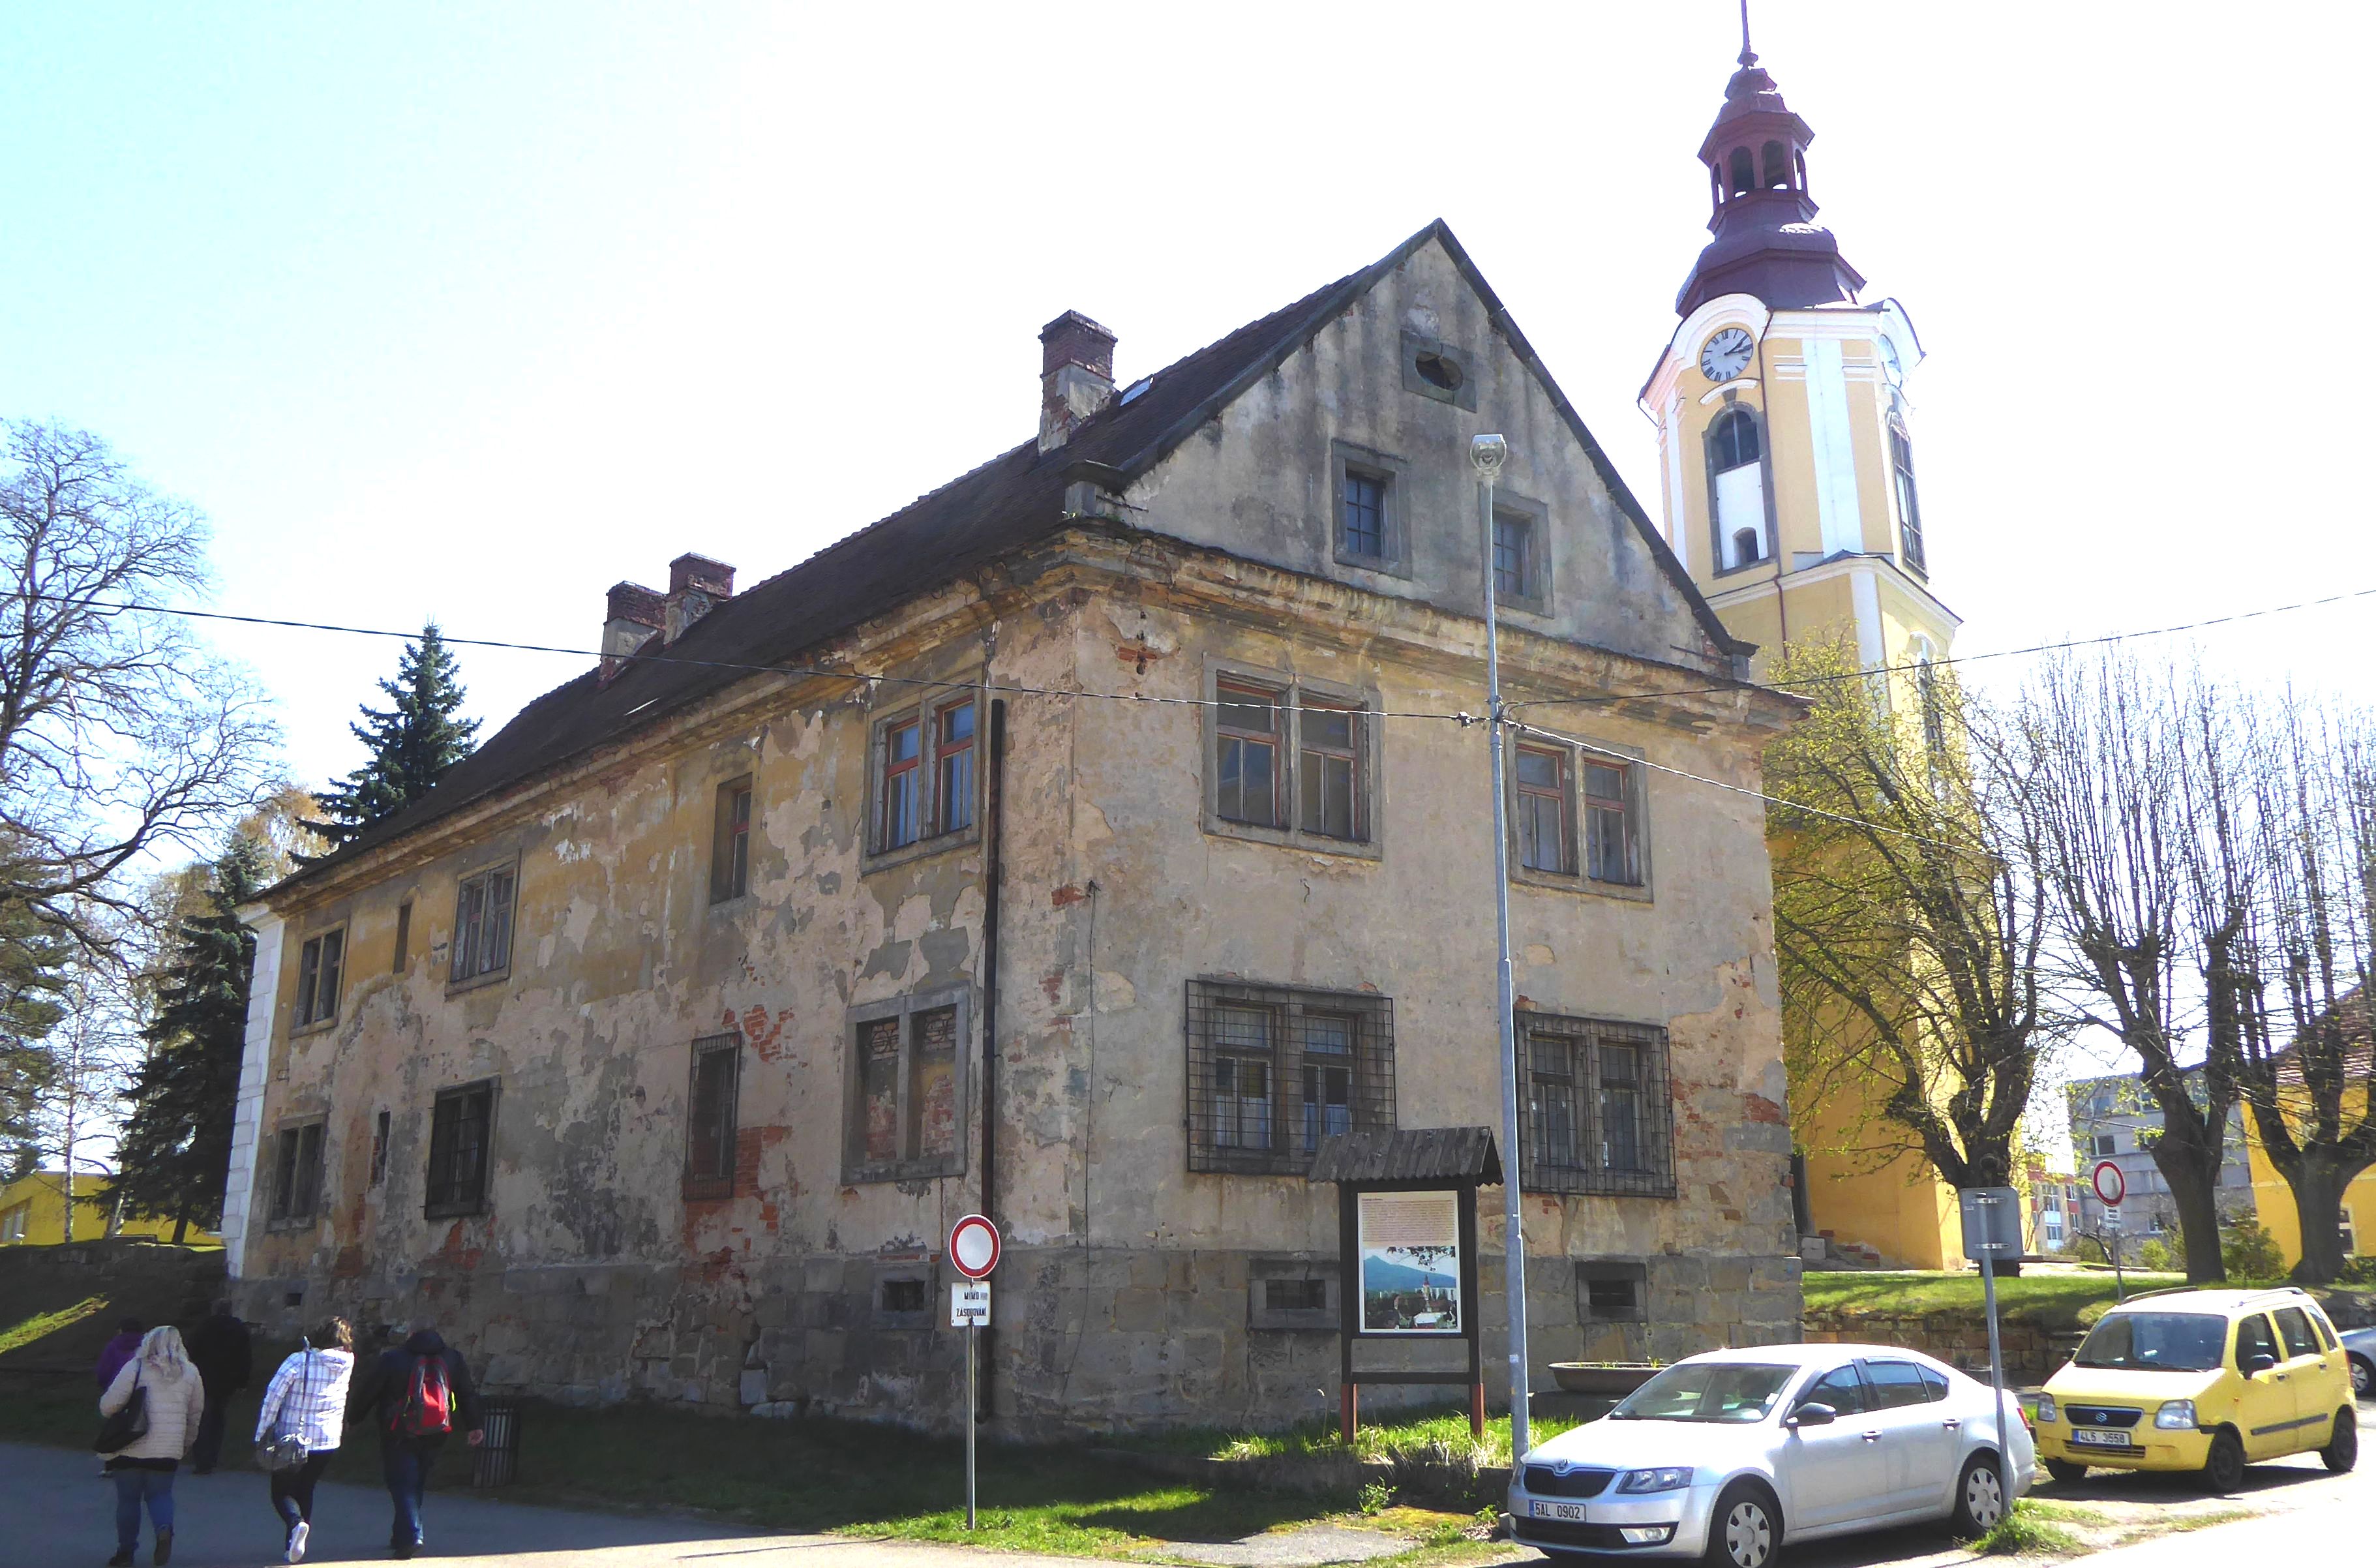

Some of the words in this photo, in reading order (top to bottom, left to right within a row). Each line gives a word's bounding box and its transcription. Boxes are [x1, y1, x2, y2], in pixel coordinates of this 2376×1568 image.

[964, 1291, 979, 1300] MIMO
[1535, 1502, 1550, 1516] 5AL
[1557, 1505, 1580, 1519] 0902
